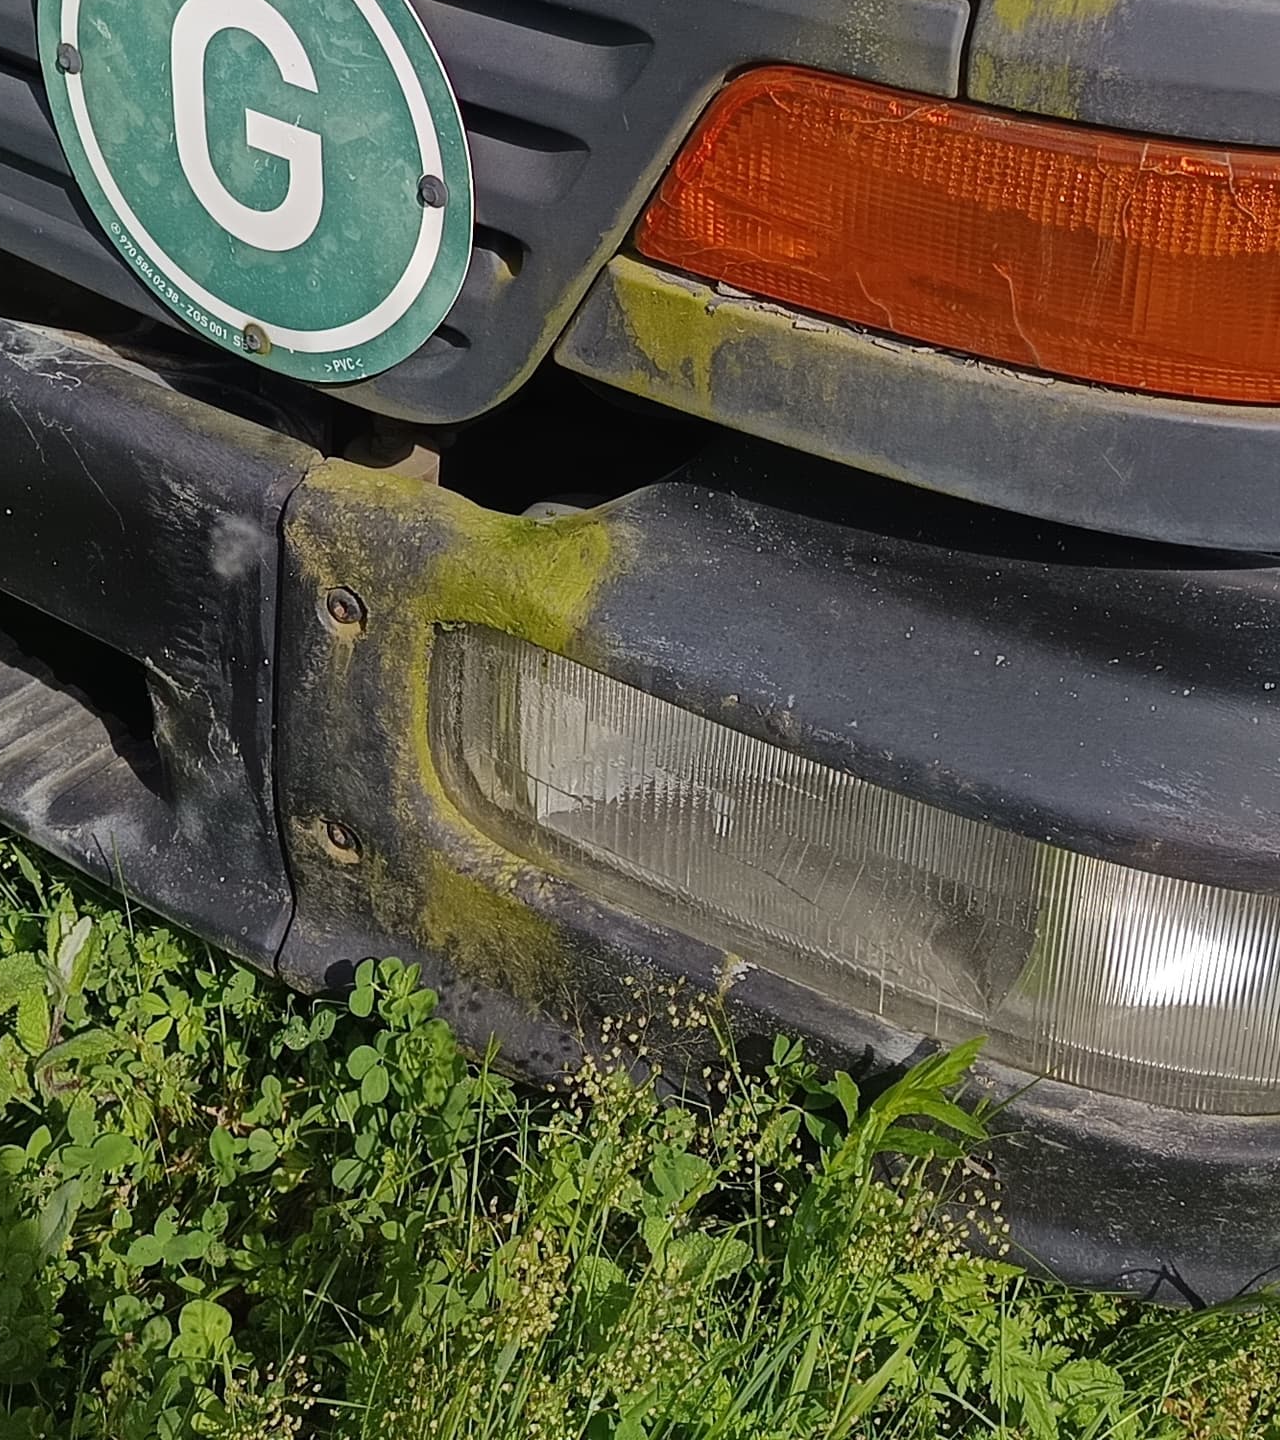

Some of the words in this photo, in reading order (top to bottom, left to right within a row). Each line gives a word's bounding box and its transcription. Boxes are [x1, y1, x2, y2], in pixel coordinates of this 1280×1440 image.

[119, 235, 136, 258] 970
[135, 256, 152, 279] 584
[152, 275, 167, 292] 02
[165, 287, 179, 304] 38
[186, 304, 209, 327] ZGS
[209, 321, 228, 340] 001
